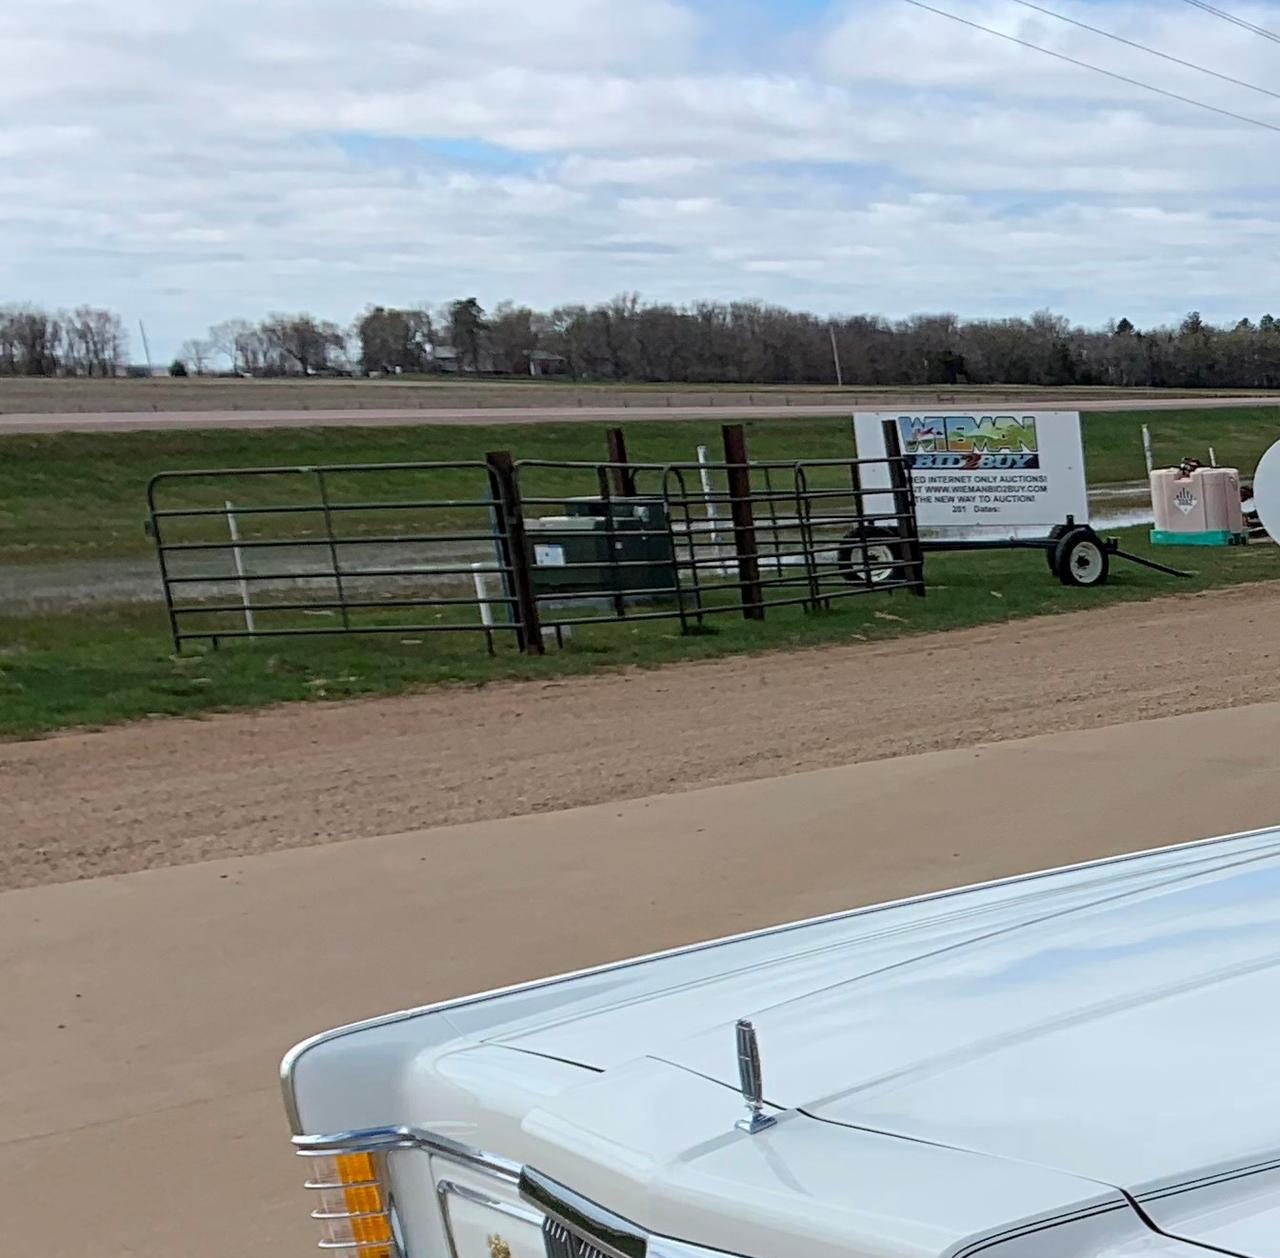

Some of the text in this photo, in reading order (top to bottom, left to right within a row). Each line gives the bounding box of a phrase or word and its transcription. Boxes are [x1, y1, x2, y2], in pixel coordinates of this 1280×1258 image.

[898, 416, 1038, 452] WIEMAN
[912, 454, 1033, 469] BID2BUY
[928, 475, 972, 483] INTERNET
[974, 475, 997, 483] ONLY
[999, 474, 1047, 483] AUCTIONS!
[934, 495, 955, 503] NEW
[957, 495, 976, 503] WAY
[979, 495, 991, 503] TO
[993, 494, 1035, 502] AUCTION!
